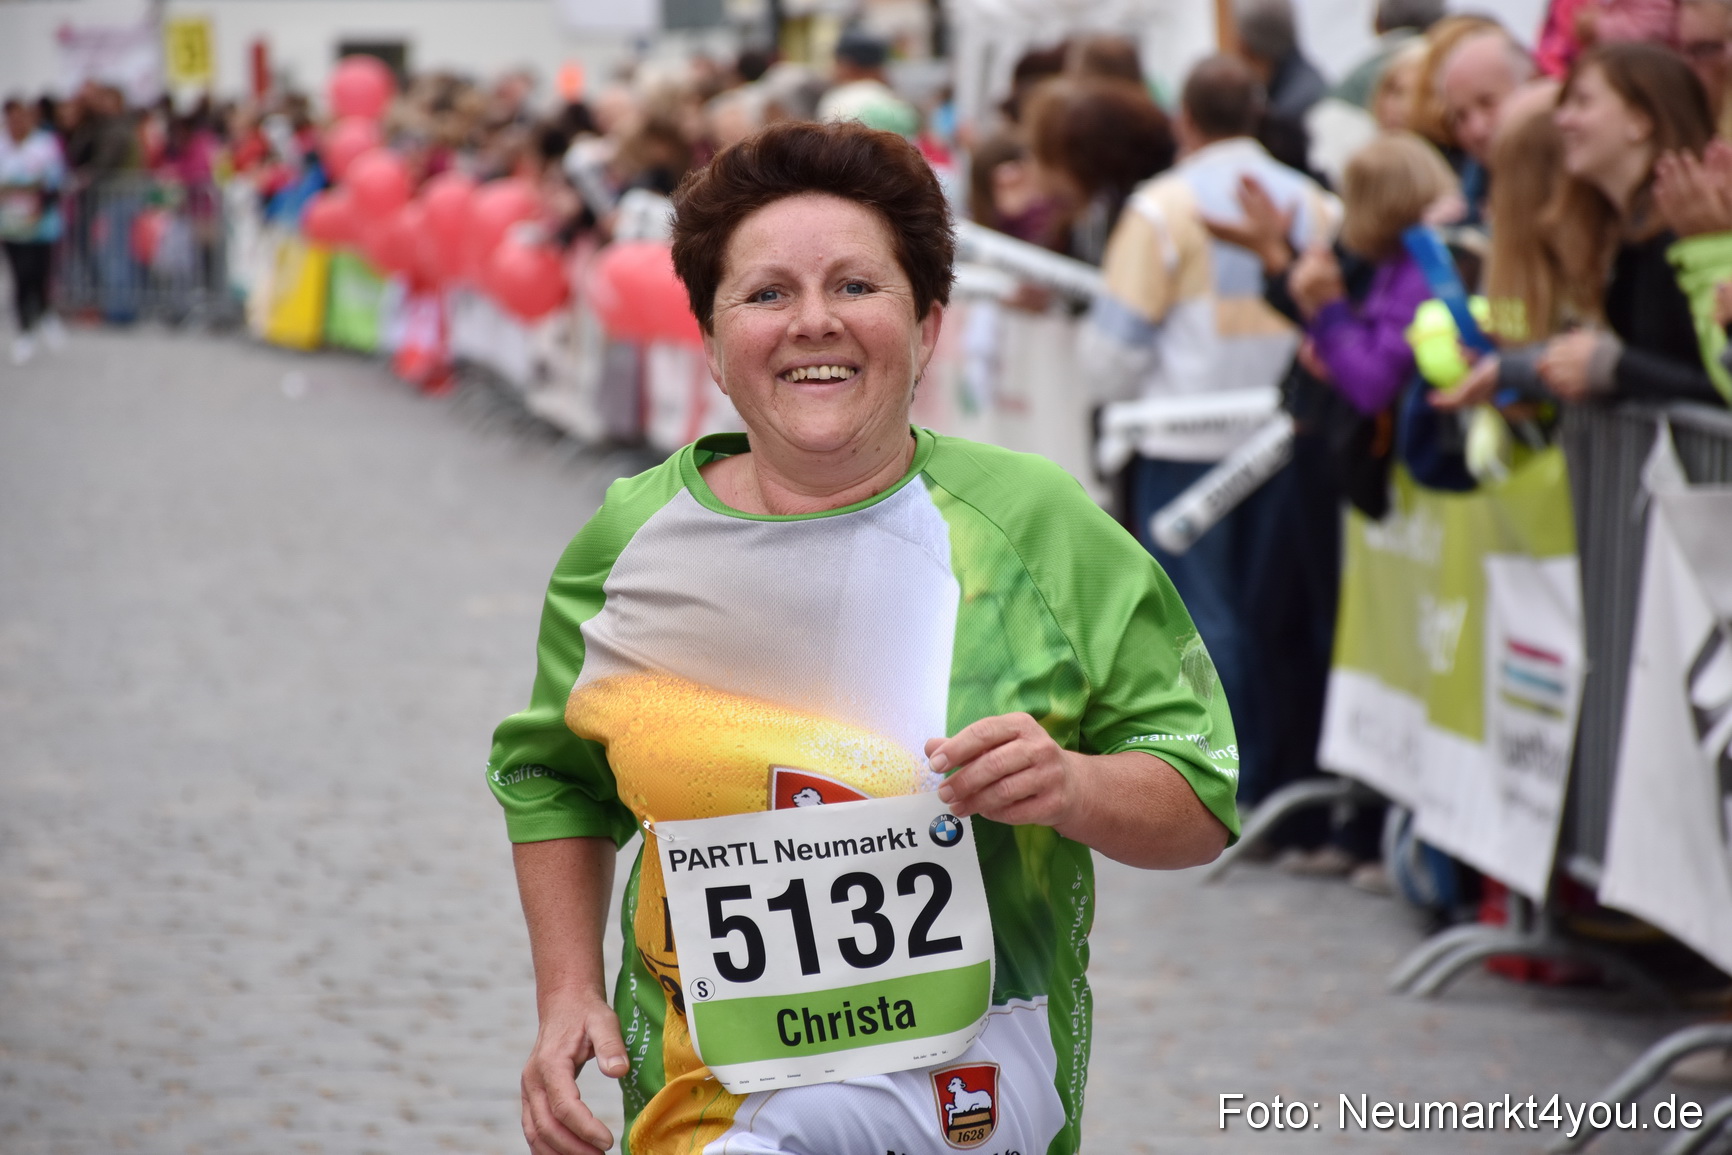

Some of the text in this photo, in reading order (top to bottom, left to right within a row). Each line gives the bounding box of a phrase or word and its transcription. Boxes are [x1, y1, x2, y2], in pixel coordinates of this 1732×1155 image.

[668, 826, 919, 872] PARTL Neumarkt
[704, 861, 964, 984] 5132
[696, 980, 709, 999] S
[776, 994, 917, 1047] Christa
[957, 1128, 985, 1143] 1628
